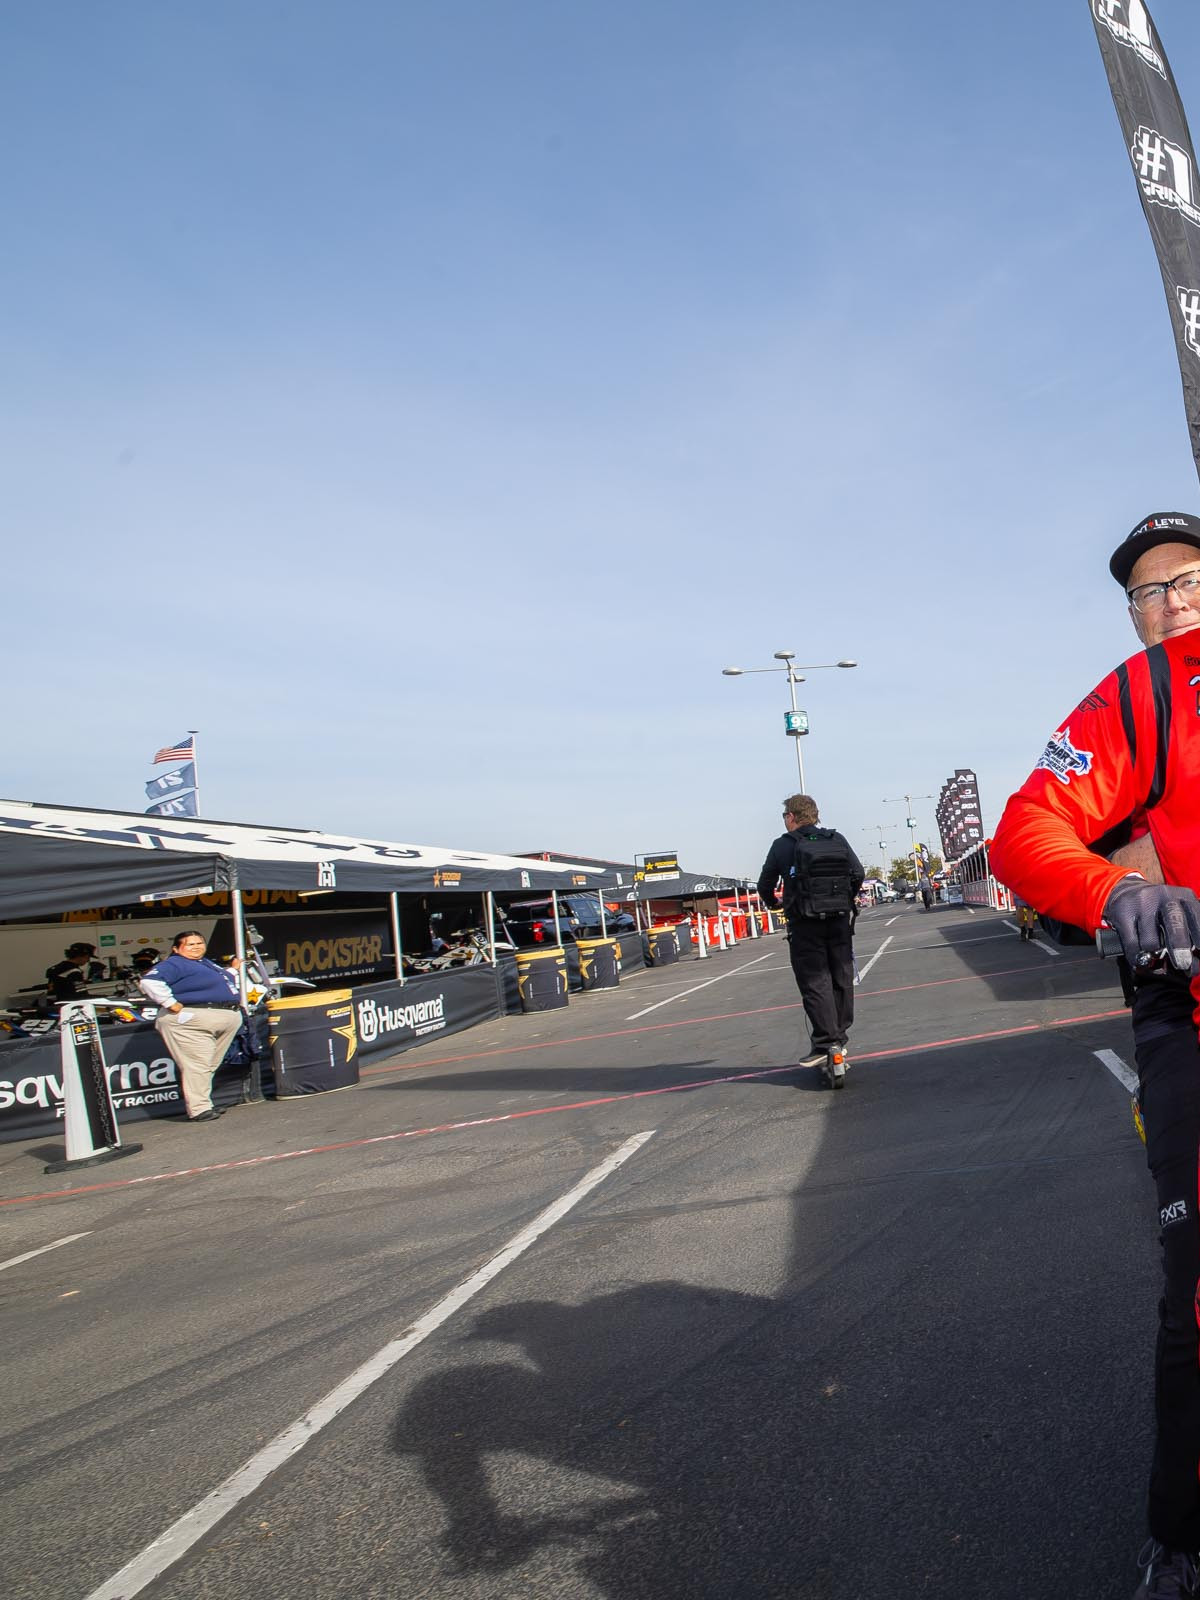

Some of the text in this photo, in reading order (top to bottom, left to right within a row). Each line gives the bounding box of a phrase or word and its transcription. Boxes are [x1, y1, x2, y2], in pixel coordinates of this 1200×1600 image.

[286, 935, 383, 976] ROCKSTAR
[377, 999, 445, 1034] Husqvarna
[125, 1091, 180, 1108] RACING
[1160, 1200, 1188, 1225] FXR
